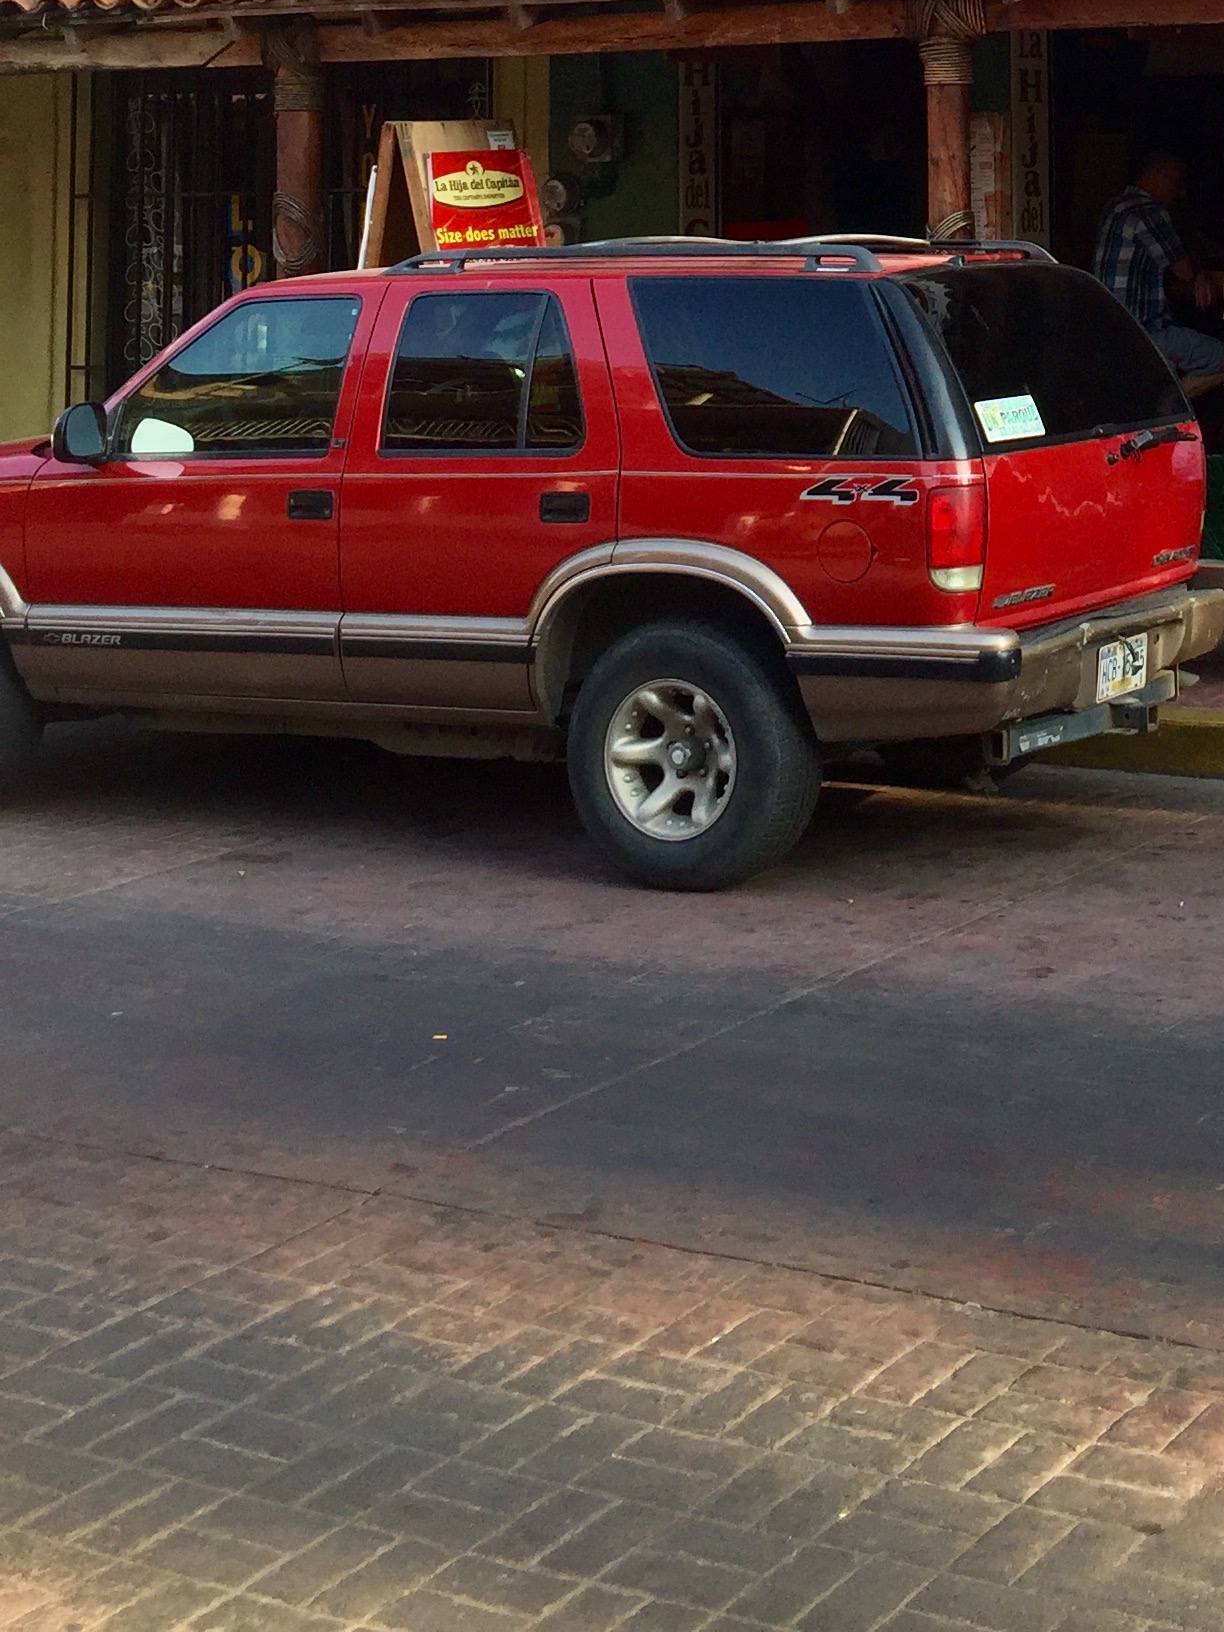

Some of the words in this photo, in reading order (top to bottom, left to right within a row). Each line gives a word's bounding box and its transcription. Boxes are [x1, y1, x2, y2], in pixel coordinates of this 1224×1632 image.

[435, 180, 447, 192] La
[449, 179, 469, 193] Hija
[470, 178, 484, 190] del
[485, 176, 520, 191] Capitán
[1021, 200, 1045, 233] del
[436, 227, 462, 244] Size
[465, 225, 496, 243] does
[498, 223, 539, 239] matter
[61, 633, 121, 646] BLAZER
